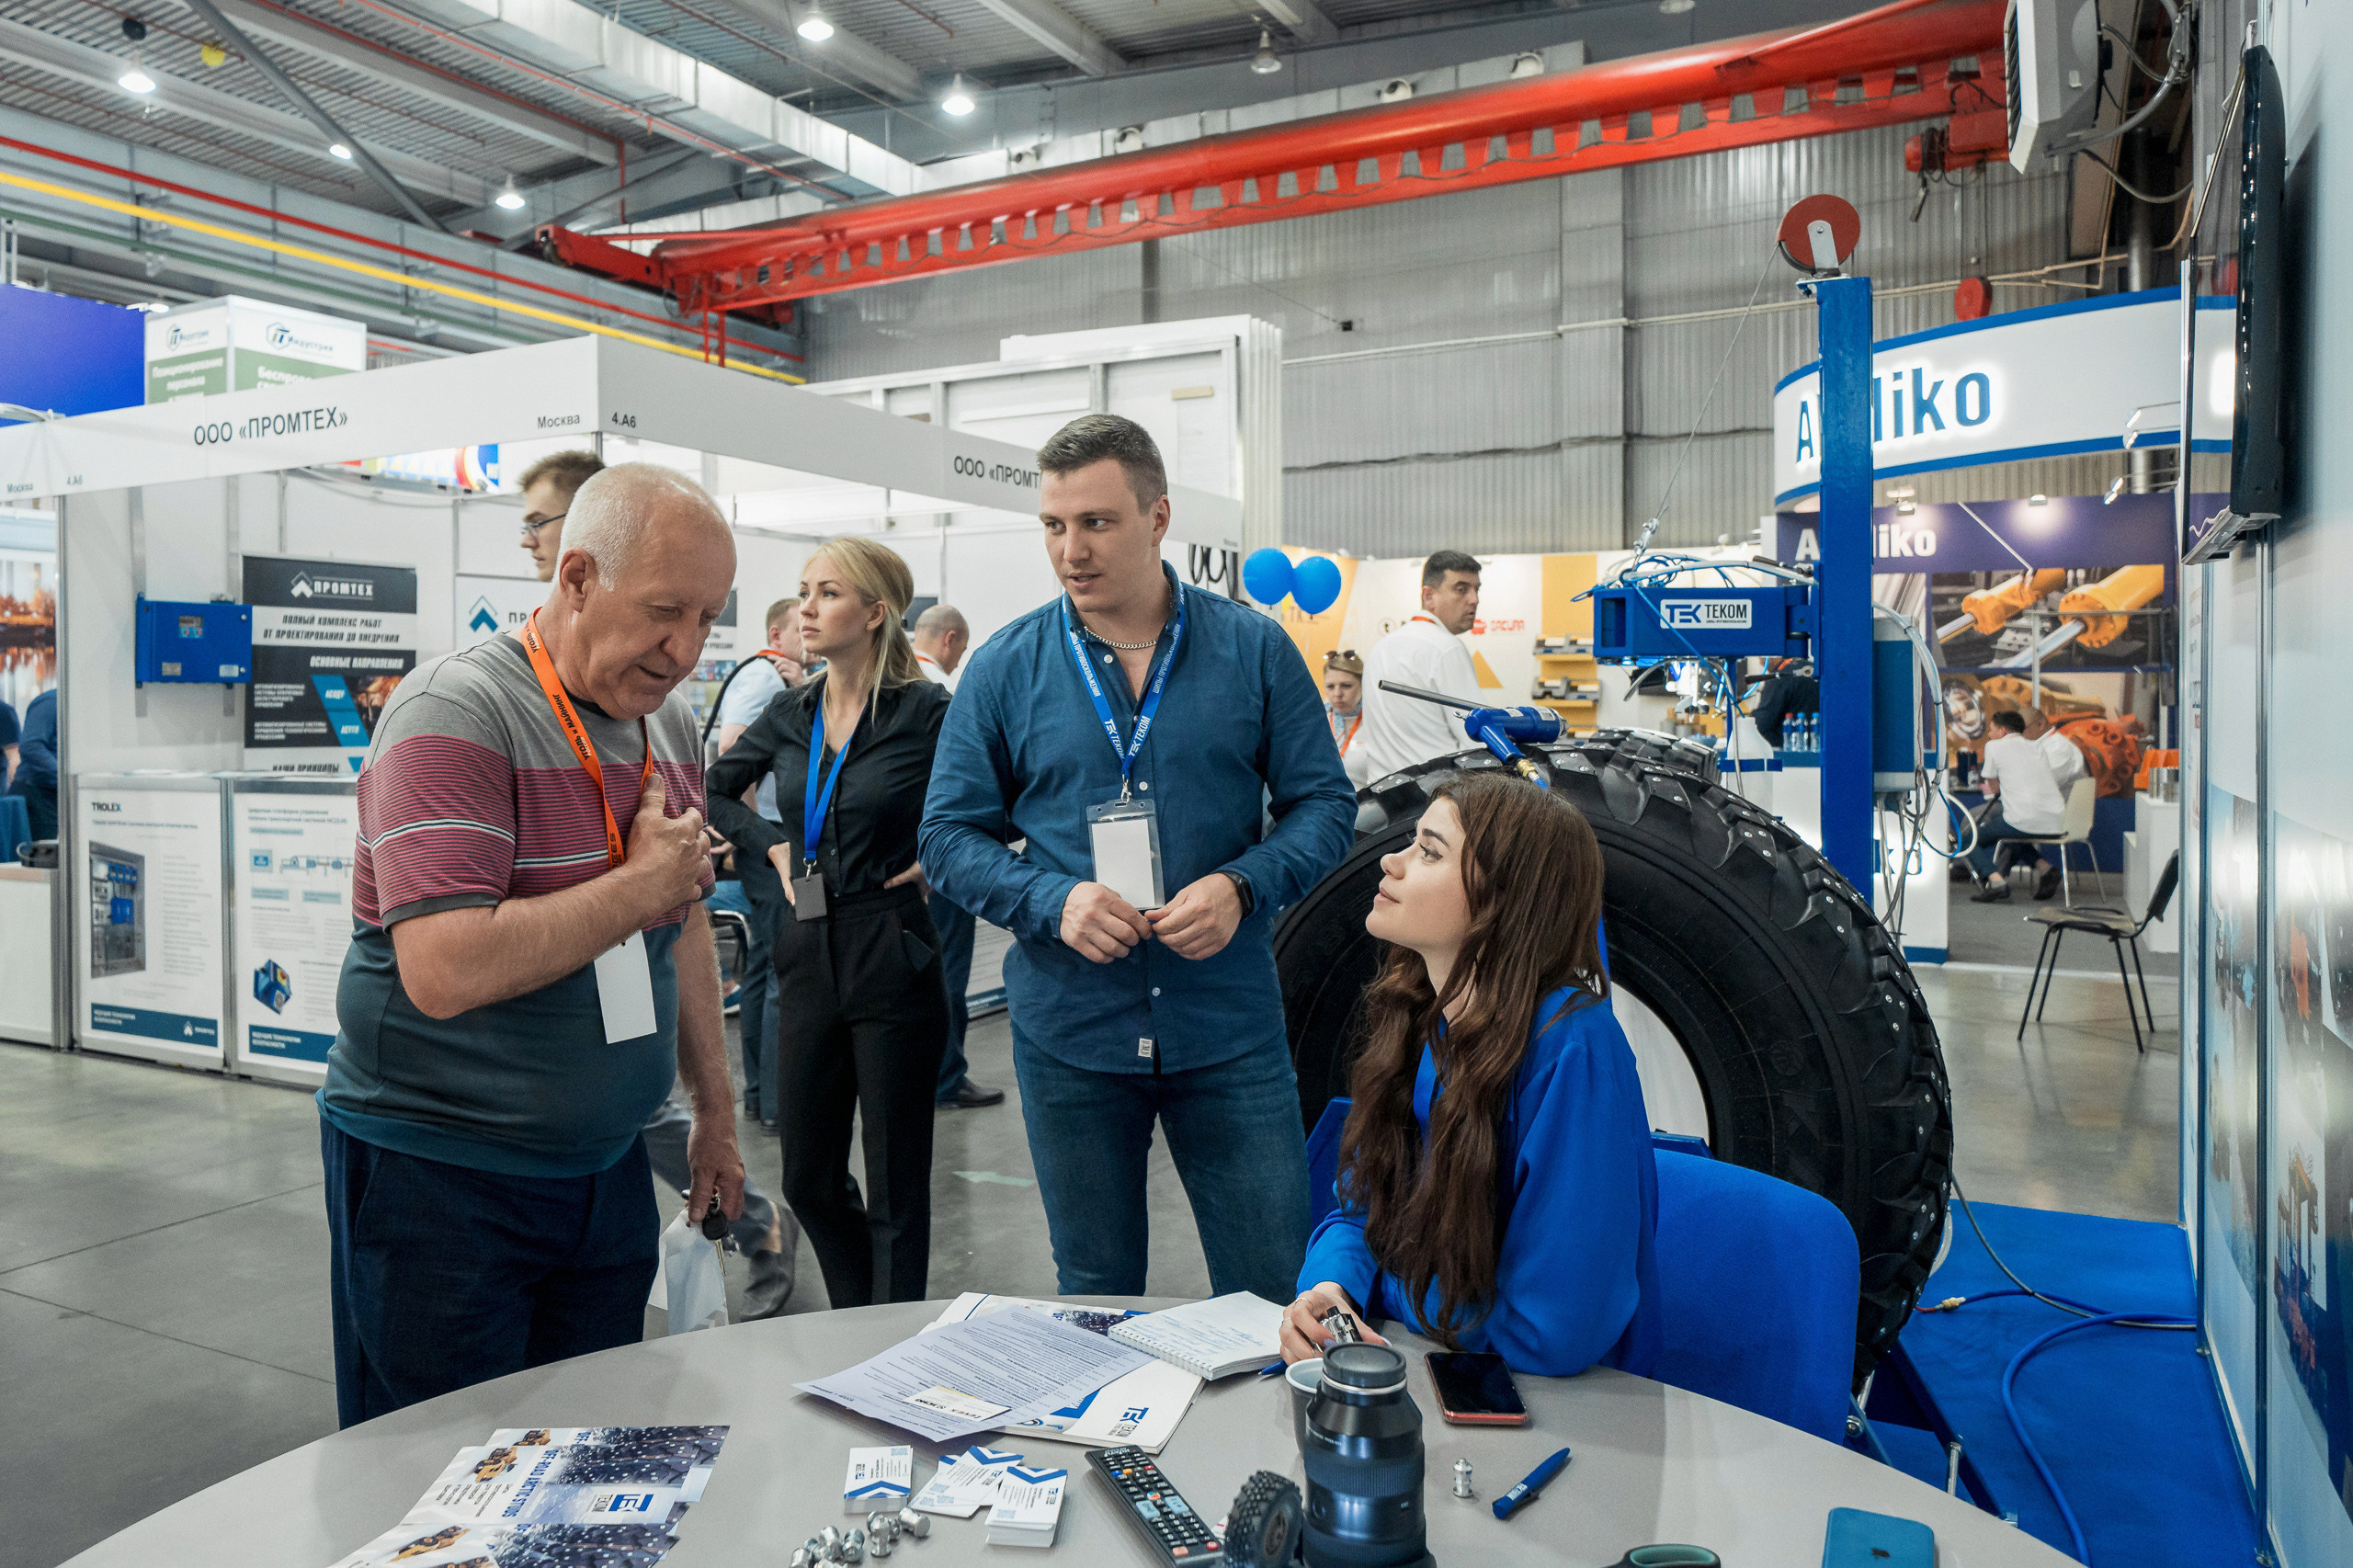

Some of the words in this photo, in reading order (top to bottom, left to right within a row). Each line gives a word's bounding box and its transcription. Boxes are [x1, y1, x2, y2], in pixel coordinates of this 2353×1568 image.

[194, 422, 233, 446] ООО
[239, 406, 348, 440] «ПРОМТЕХ»
[538, 415, 580, 428] Москва
[954, 456, 984, 478] ООО
[989, 463, 1040, 489] «ПРОМТ
[313, 580, 373, 597] ПРОМТЕХ
[282, 614, 315, 625] ПОЛНЫЙ
[318, 616, 357, 627] КОМПЛЕКС
[360, 618, 381, 628] РАБОТ
[263, 629, 273, 639] ОТ
[276, 630, 344, 642] ПРОЕКТИРОВАНИЯ
[346, 632, 356, 642] ДО
[358, 633, 400, 643] ВНЕДРЕНИЯ
[552, 694, 574, 730] МАЙНИНГ
[575, 735, 590, 761] УГОЛЬ
[91, 801, 121, 812] TROLEX
[530, 1449, 560, 1476] OFF-ROAD
